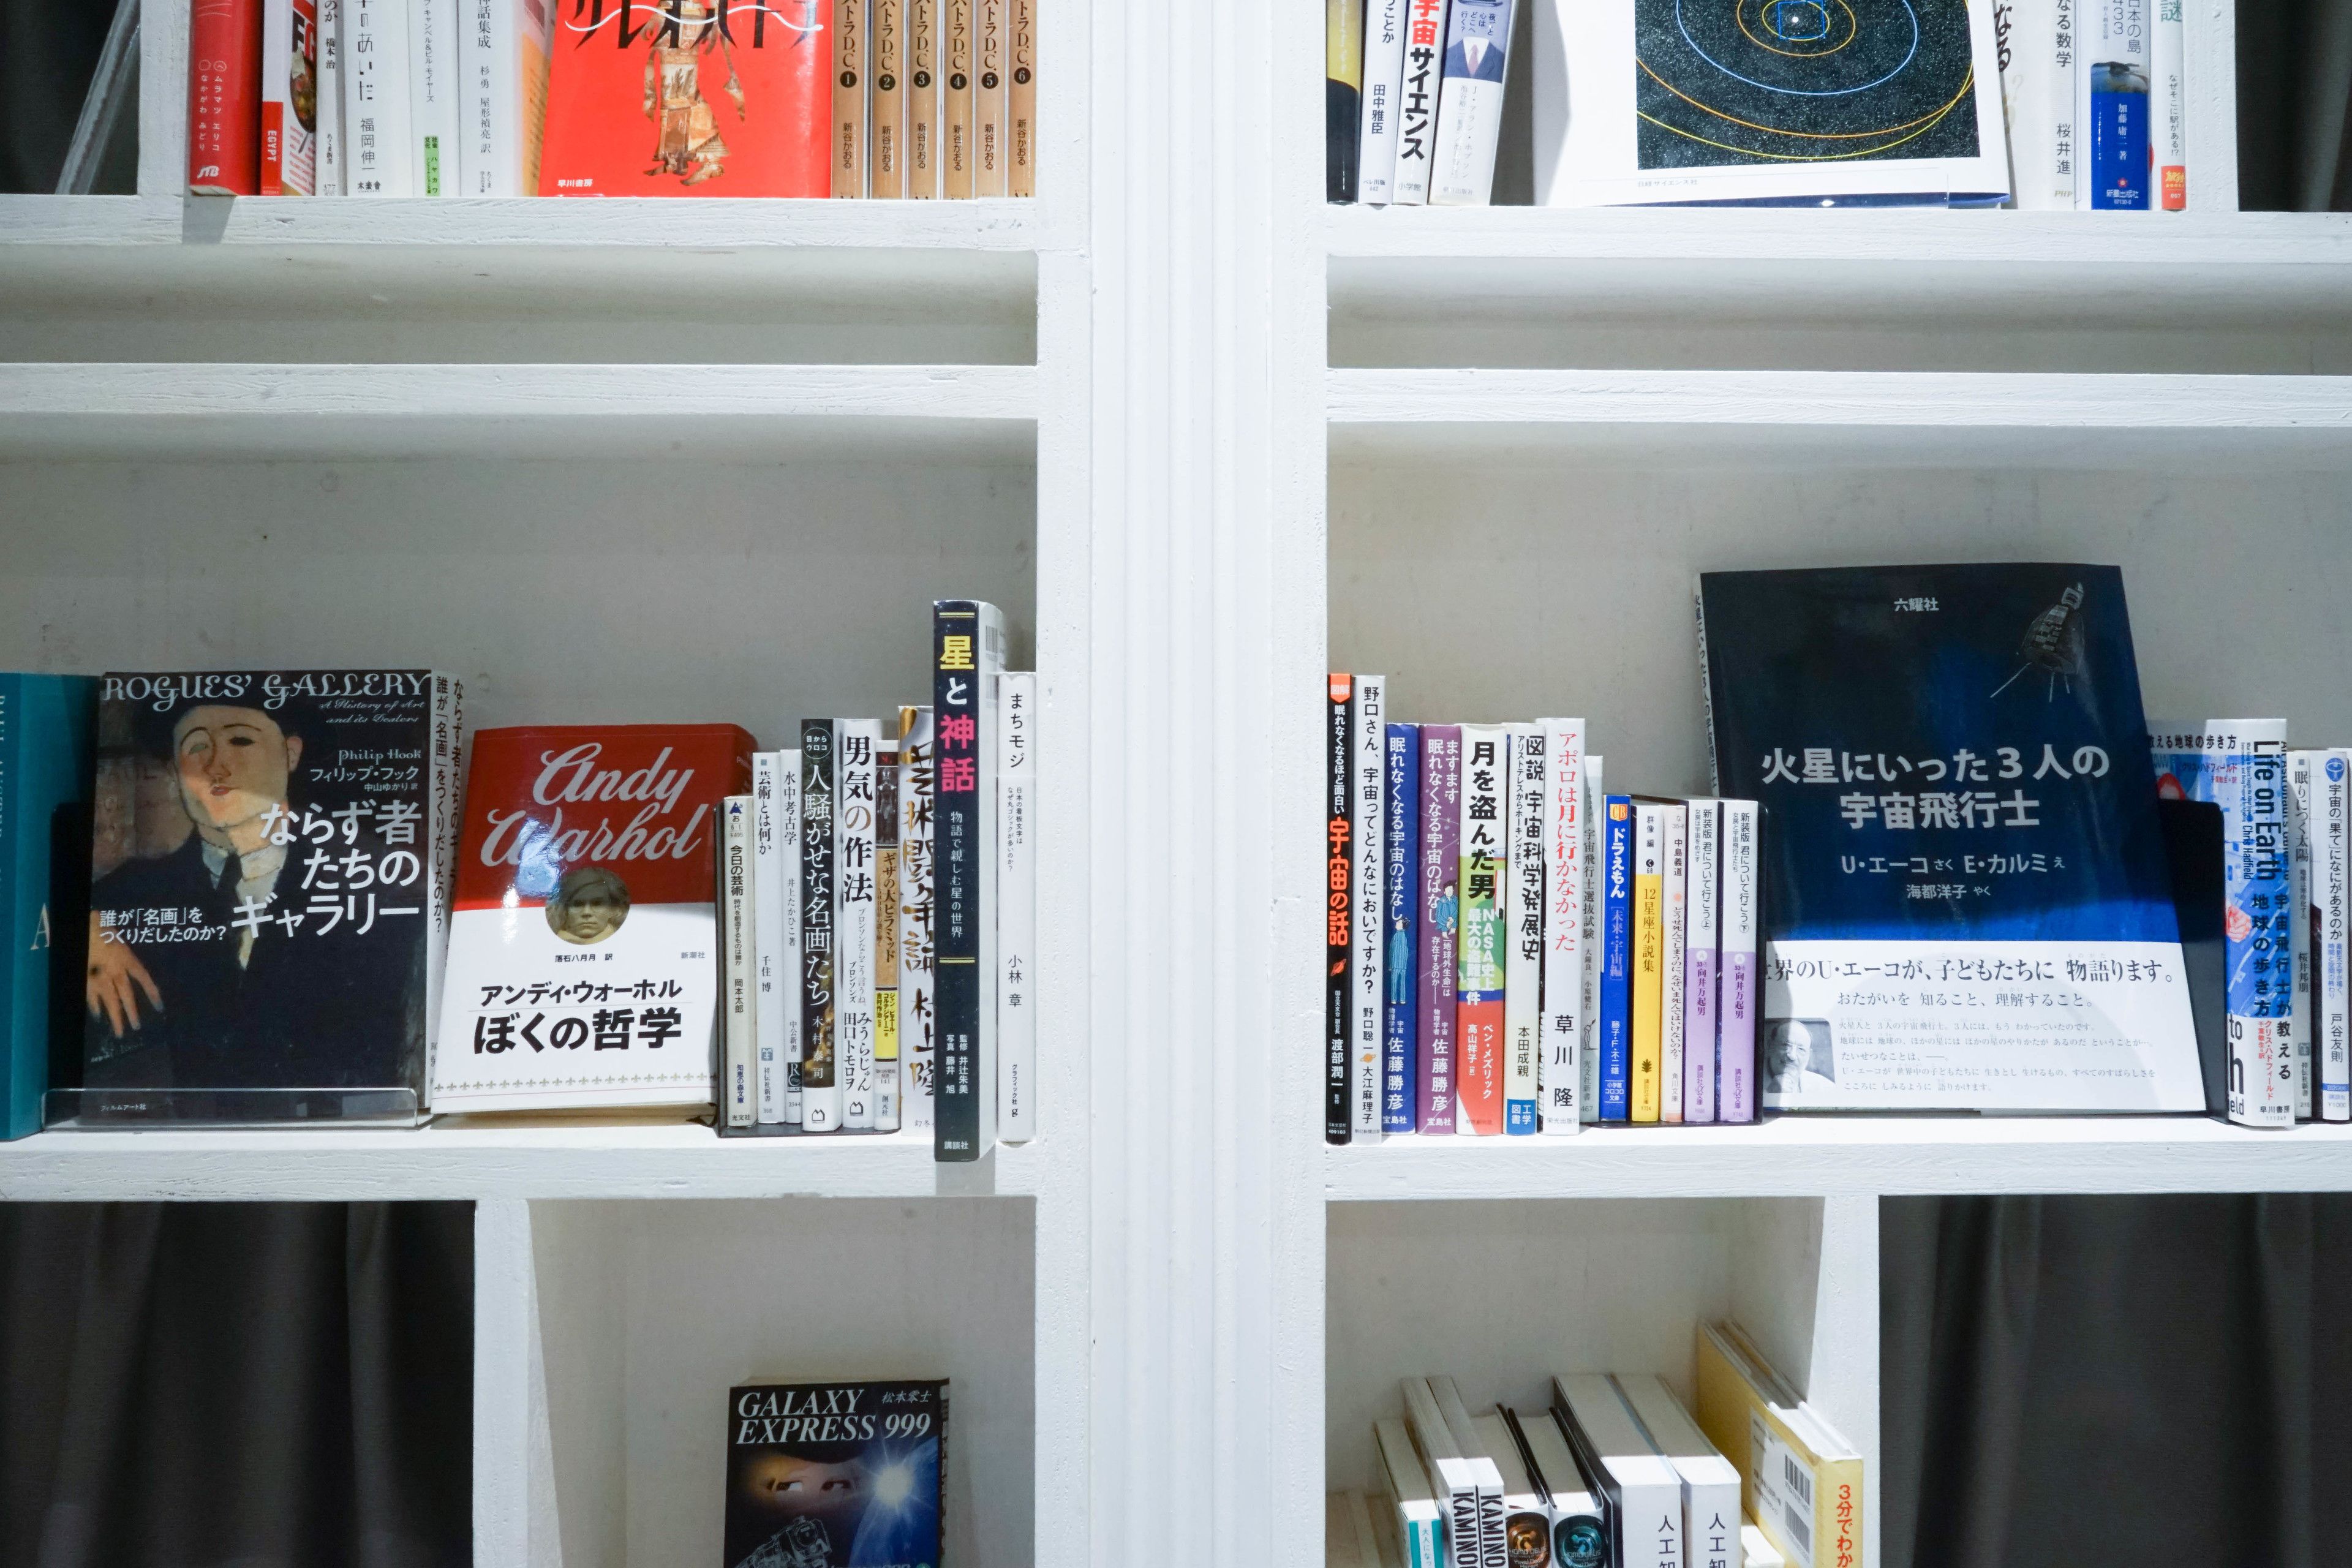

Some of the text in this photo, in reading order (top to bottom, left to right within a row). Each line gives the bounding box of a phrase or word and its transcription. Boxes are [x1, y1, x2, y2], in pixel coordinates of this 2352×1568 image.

[1371, 84, 1386, 135] 田中雅臣
[266, 129, 278, 162] EGYPT
[360, 117, 375, 170] 福岡伸一
[481, 143, 491, 154] 訳
[843, 122, 853, 170] 新谷かおる
[881, 126, 892, 173] 新谷かおる
[917, 123, 927, 170] 新谷かおる
[953, 125, 963, 172] 新谷かおる
[984, 124, 994, 171] 新谷かおる
[1017, 119, 1027, 166] 新谷かおる
[2056, 123, 2071, 175] 桜井進
[556, 178, 594, 188] 早川書房
[262, 672, 432, 710] GALLERY
[384, 699, 399, 714] of
[401, 699, 425, 709] Art
[939, 635, 976, 793] 星と神話
[325, 713, 420, 723] and its Dealers
[1009, 693, 1025, 769] まちモジ
[309, 766, 420, 783] フィリップ・フック
[338, 748, 422, 766] Philip Hook
[532, 742, 695, 814] Andy
[1333, 704, 1346, 815] 眠れなくなるほど面白い
[1445, 740, 1460, 804] ますます
[1760, 745, 2111, 785] 火星にいった3人の
[364, 783, 409, 792] 中山ゆかり
[783, 771, 797, 845] 水中考古学
[1515, 735, 1526, 869] アリストテレスからホーキングまで
[1839, 790, 2040, 831] 宇宙飛行士
[2253, 741, 2283, 881] Life on Earth
[260, 799, 423, 847] ならず者
[480, 802, 709, 867] Warhol
[757, 770, 771, 855] 芸術とは何か
[843, 736, 873, 903] 男気の作法
[1389, 737, 1406, 921] 眠れなくなる宇宙のはなし
[1427, 739, 1444, 923] 眠れなくなる宇宙のはなし
[1468, 741, 1497, 900] 月を盗んだ男
[1646, 815, 1654, 834] 群像
[2242, 825, 2253, 845] Chris
[2294, 770, 2309, 862] 眠りにつく太陽
[1521, 735, 1545, 960] 図説 宇宙科学発展史
[1555, 732, 1578, 951] アポロは月に行かなかった
[1610, 827, 1626, 899] ドラえもん
[1674, 839, 1683, 876] 中島義道
[1702, 809, 1713, 919] 新装版 君について行こう
[1841, 854, 2066, 875] U・エーコ さく E・カルミ え
[2242, 848, 2253, 880] Hadfield
[2328, 783, 2343, 941] 宇宙の「果て」になにがあるのか
[301, 847, 421, 891] たちの
[803, 764, 832, 1006] 人騒がせな名画たち
[949, 810, 964, 939] 物語で親しむ星の世界
[1328, 816, 1349, 946] 宇宙の話
[1583, 828, 1596, 940] 宇宙飛行士選抜試験
[1740, 812, 1751, 923] 新装版 君について行こう
[1906, 883, 1991, 900] 海都洋子 やく
[99, 907, 203, 928] 誰が「名画」を
[231, 893, 420, 939] ギャラリー
[730, 845, 744, 1014] 今日の芸術 岡本太郎
[1642, 888, 1656, 973] 12星座小説集
[554, 952, 613, 963] 落石八月月 訳
[680, 951, 706, 960] 新潮社
[761, 956, 771, 992] 千住 博
[1442, 938, 1452, 997] 「地球外生命」は
[1481, 908, 1495, 992] NASA史上
[2066, 959, 2173, 982] 物語ります。
[2252, 893, 2272, 1017] 地球の歩き方
[480, 979, 683, 1007] アンディ・ウォーホル
[848, 961, 857, 1004] ブロンソンズ
[1008, 954, 1023, 1008] 小林 章
[1697, 968, 1707, 1016] 向井万起男
[1735, 971, 1744, 1019] 向井万起男
[1837, 992, 2093, 1008] おたがいを 知ること、 理解すること。
[473, 1006, 683, 1055] ぼくの哲学
[843, 1012, 857, 1091] 田口トモロヲ
[857, 1012, 873, 1092] みうらじゅん
[946, 1034, 956, 1052] 写真
[1467, 1023, 1478, 1064] 高山祥子
[1517, 1026, 1530, 1077] 本田成親
[1611, 1020, 1620, 1075] 藤子・F・不二雄
[2330, 1013, 2343, 1063] 戸谷友則
[958, 1034, 969, 1095] 監修 井辻朱美
[1331, 1039, 1344, 1087] 渡部潤一
[1362, 1007, 1374, 1125] 野口聡一 大江麻理子
[1387, 1037, 1404, 1110] 佐藤勝彦
[1431, 1038, 1449, 1112] 佐藤勝彦
[1482, 1024, 1494, 1099] ベン・メズリック
[2264, 1020, 2274, 1101] クリス・ハドフィールド
[1382, 1115, 1408, 1125] 宝島社
[1427, 1117, 1452, 1126] 宝島社
[1553, 1088, 1574, 1108] 隆
[2260, 1105, 2290, 1114] 早川書房
[944, 1140, 970, 1151] 講談社
[737, 1389, 865, 1418] GALAXY
[736, 1412, 931, 1446] EXPRESS 999
[1836, 1483, 1853, 1568] 3分でわか
